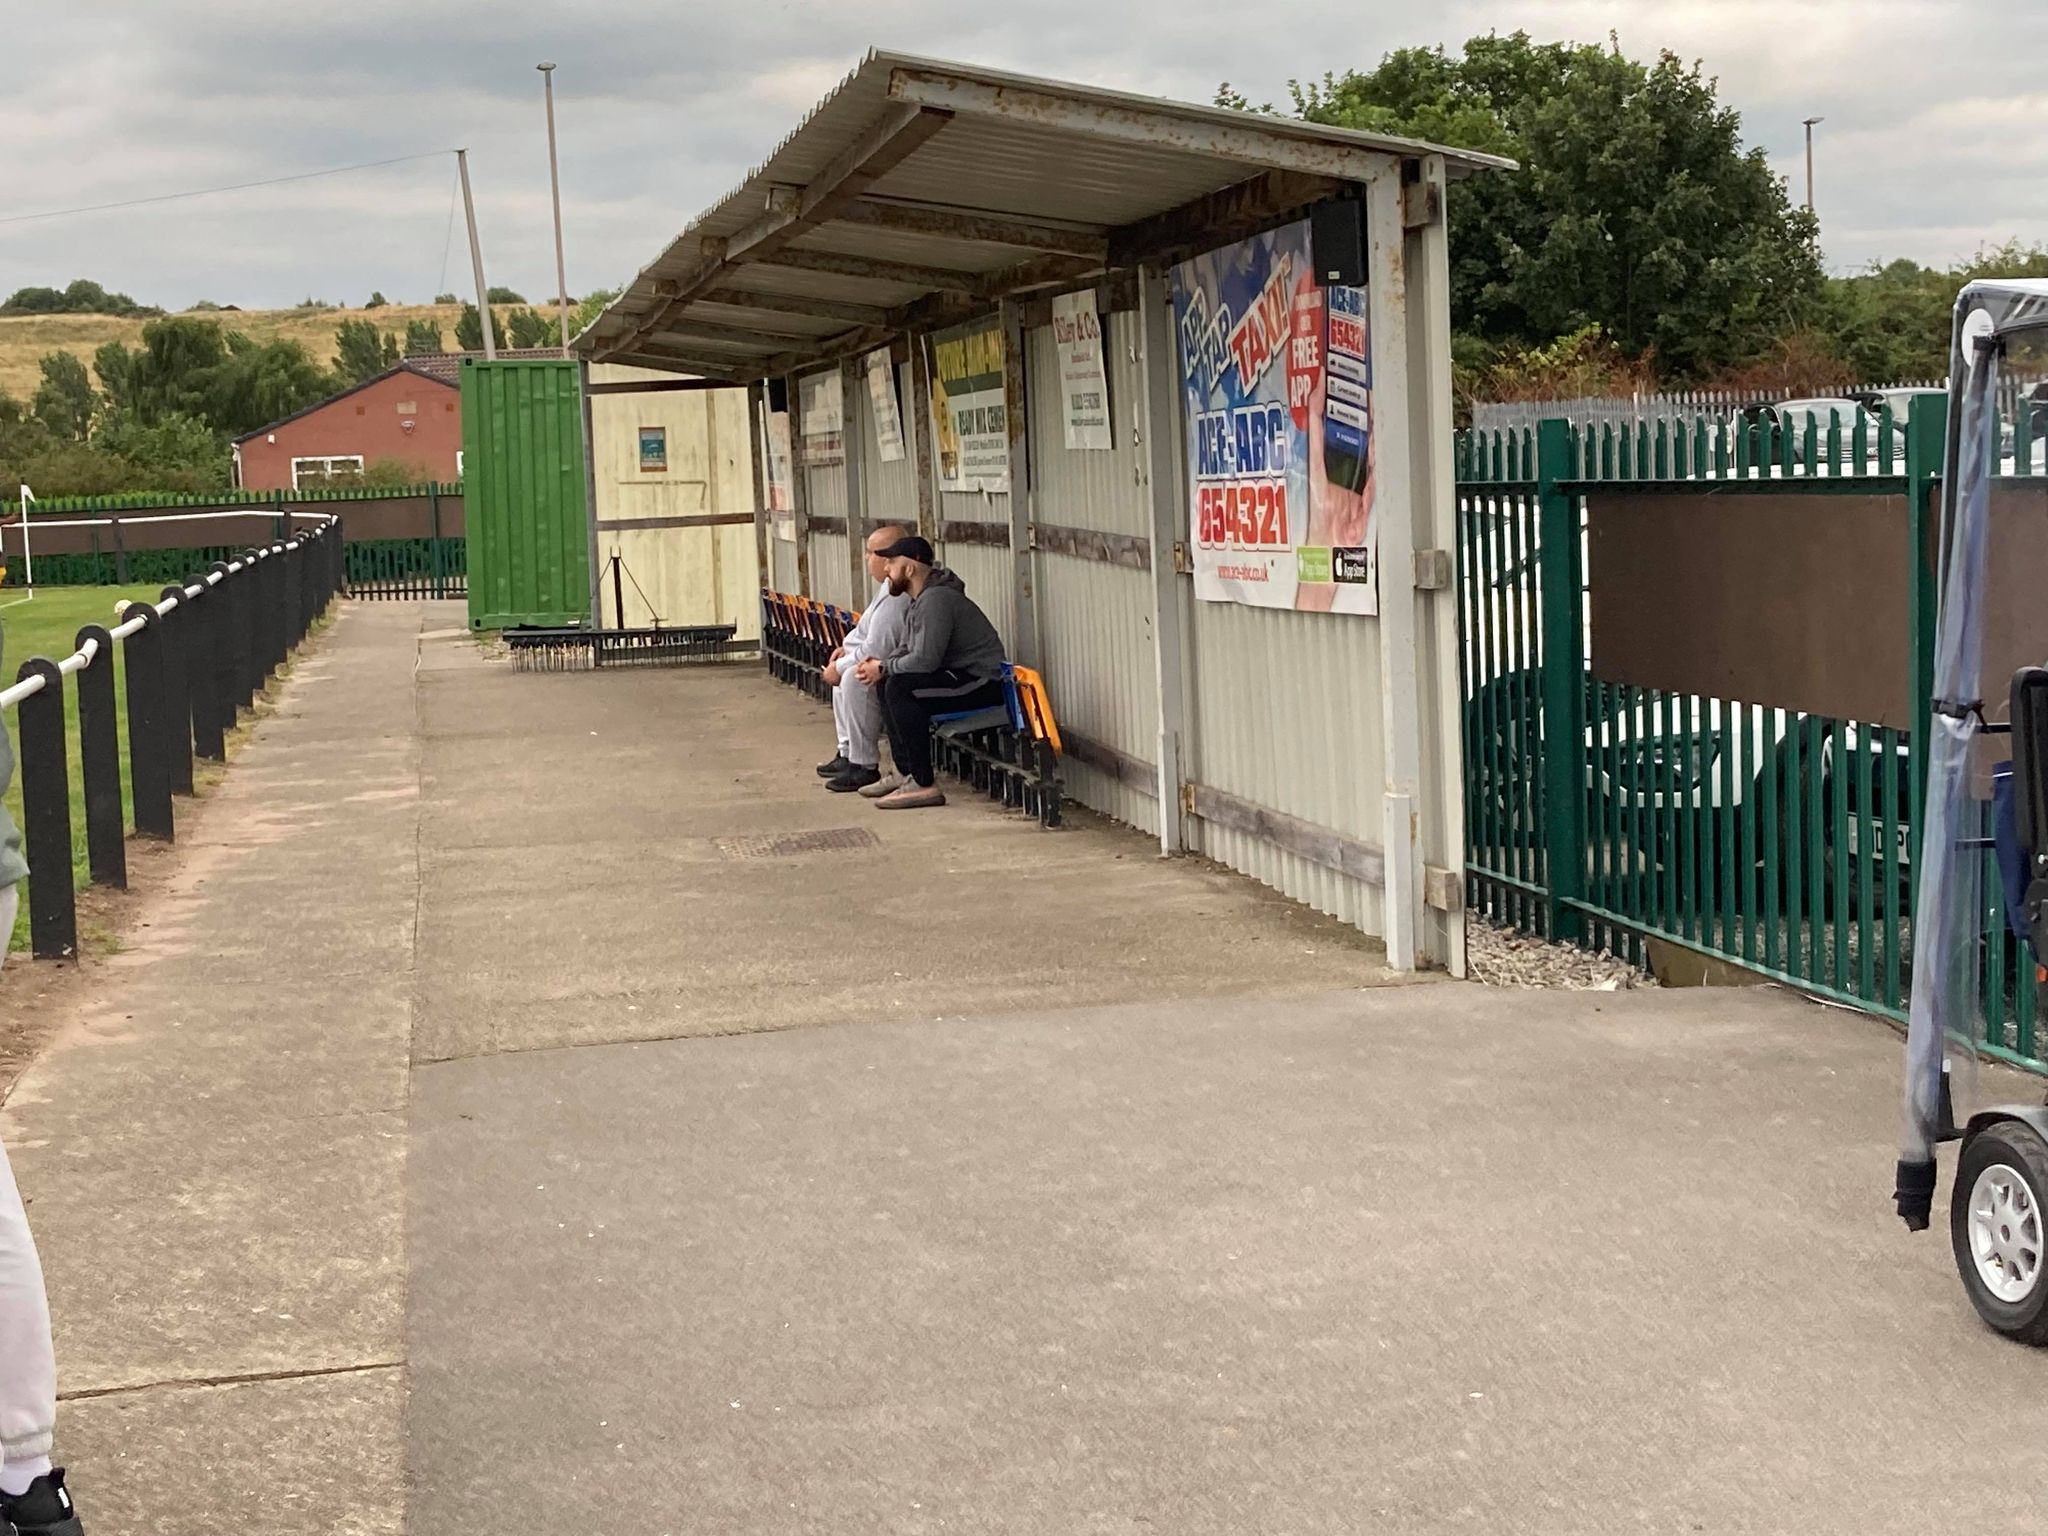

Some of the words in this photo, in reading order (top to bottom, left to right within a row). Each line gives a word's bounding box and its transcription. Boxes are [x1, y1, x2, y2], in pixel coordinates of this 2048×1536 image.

[1183, 288, 1206, 378] APP
[1202, 303, 1231, 390] TAP
[1228, 268, 1291, 396] TAXI!
[1291, 335, 1319, 370] FREE
[1291, 375, 1312, 408] APP
[1197, 404, 1286, 478] ACE-ABC
[1198, 483, 1289, 547] 654321
